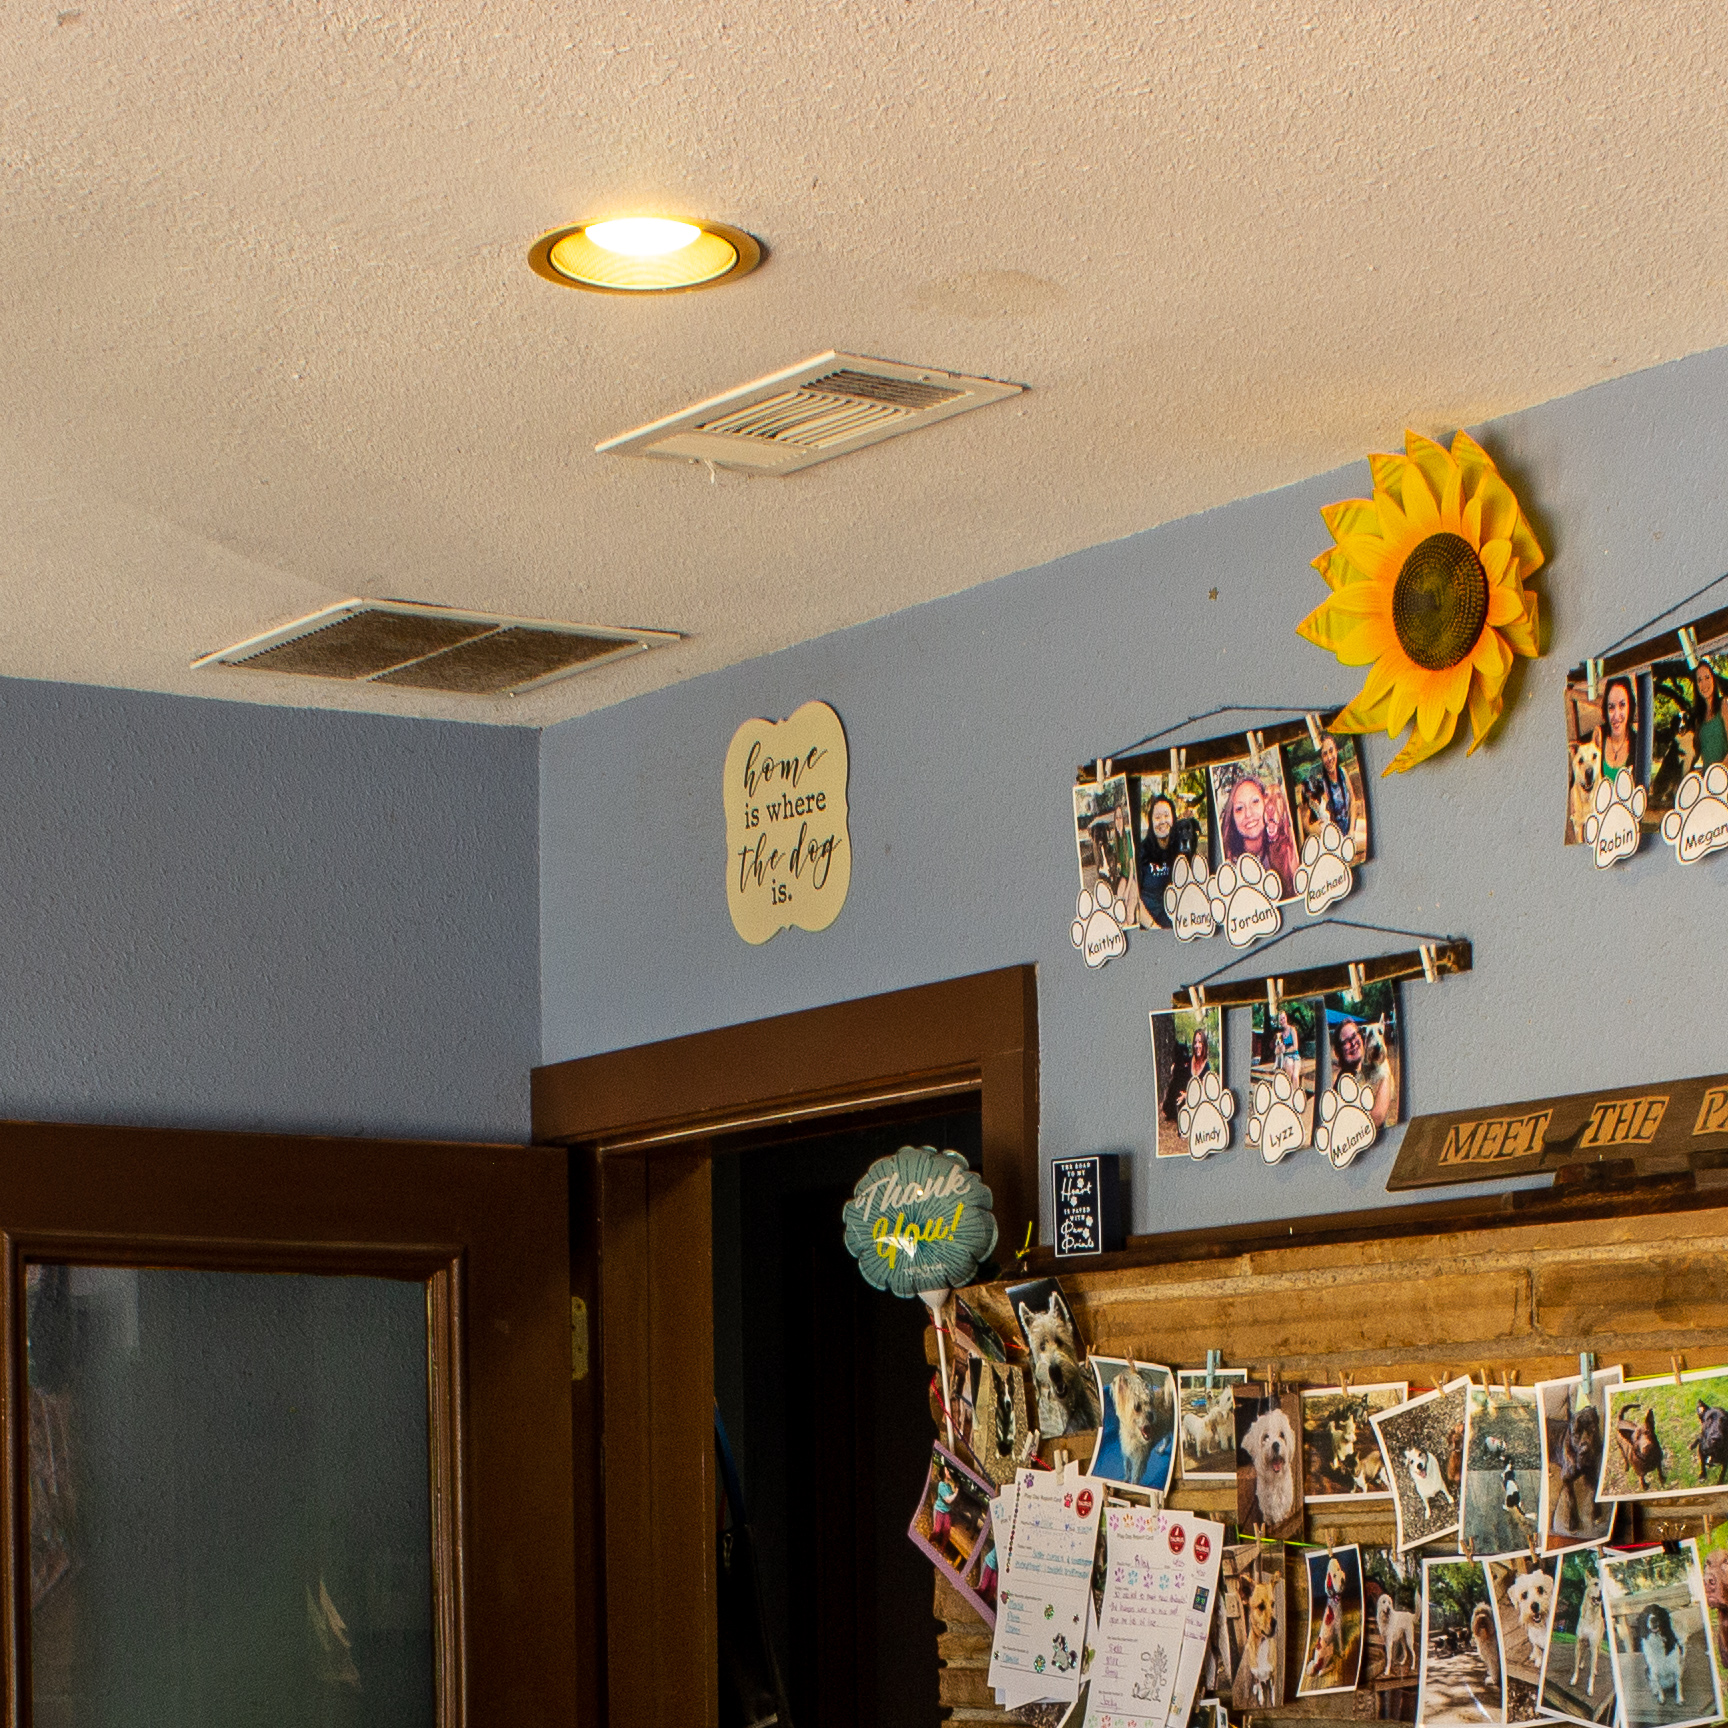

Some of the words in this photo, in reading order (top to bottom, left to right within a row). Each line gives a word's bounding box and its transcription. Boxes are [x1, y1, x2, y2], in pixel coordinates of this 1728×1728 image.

[744, 741, 828, 798] home
[745, 803, 760, 829] is
[767, 791, 826, 822] where
[1599, 829, 1634, 856] Robin
[1685, 822, 1728, 851] Megan
[738, 833, 786, 893] the
[789, 821, 842, 890] dog
[772, 879, 792, 905] is.
[1308, 870, 1347, 900] Rachael
[1230, 908, 1275, 933] Jordan
[1087, 934, 1121, 957] Kaitlyn
[1195, 1128, 1221, 1145] Mindy
[1270, 1126, 1294, 1148] Lyzz
[1332, 1124, 1371, 1160] Melanie
[1442, 1111, 1551, 1165] MEET
[1584, 1099, 1667, 1143] THE
[855, 1165, 970, 1221] Thank
